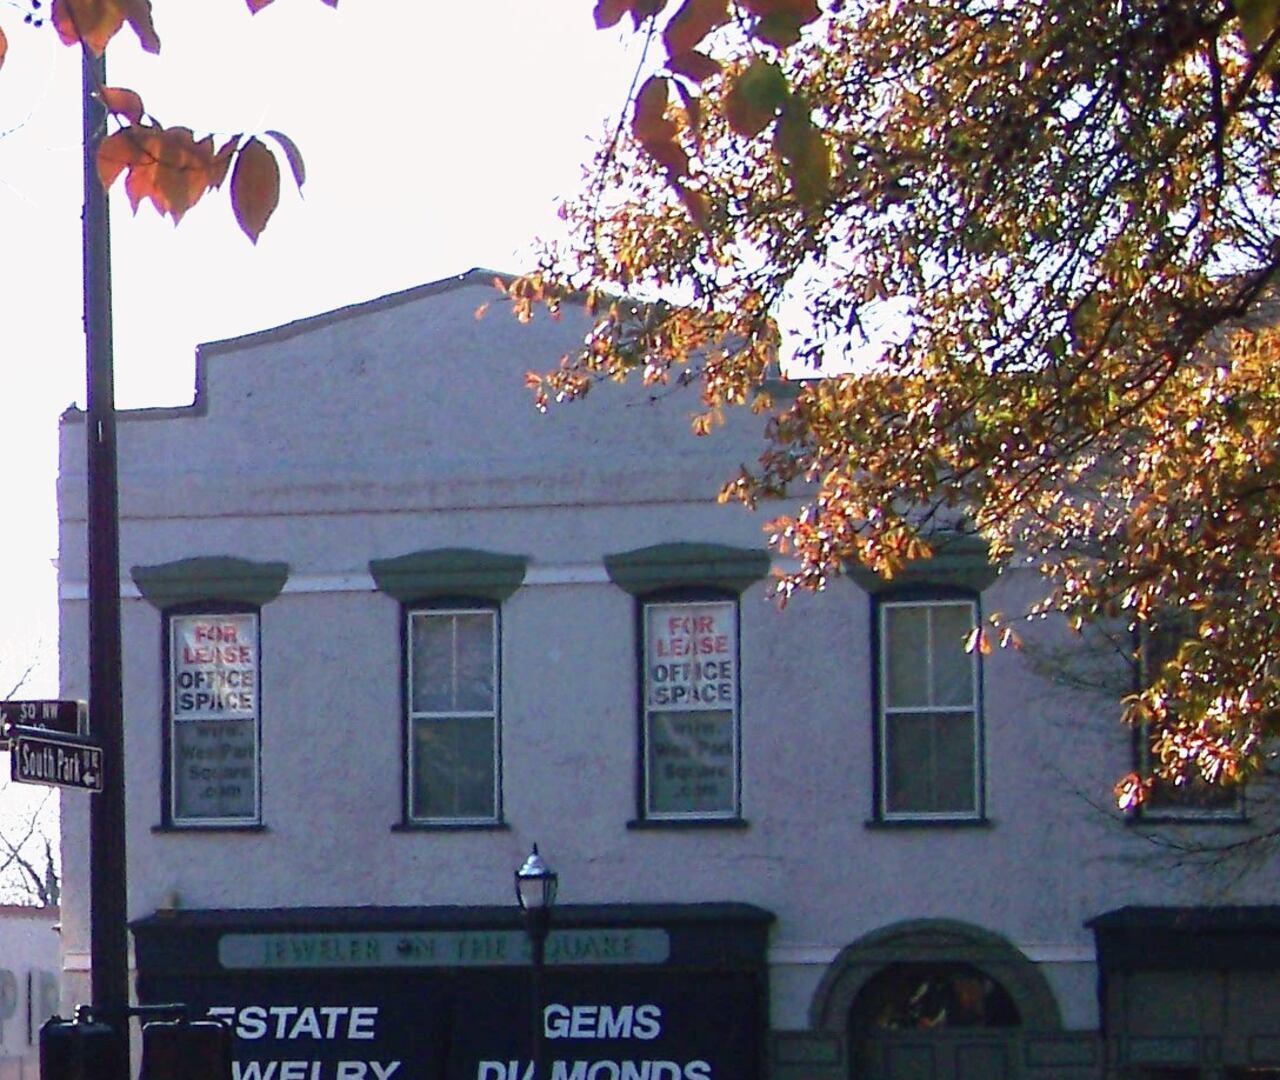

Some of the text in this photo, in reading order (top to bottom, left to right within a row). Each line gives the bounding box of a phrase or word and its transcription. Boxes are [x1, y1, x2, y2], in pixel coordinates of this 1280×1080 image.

[194, 624, 238, 643] FOR
[668, 616, 715, 636] FOR
[183, 646, 252, 665] LEASE
[656, 636, 729, 658] LEASE
[178, 669, 254, 689] OFFICE
[653, 660, 733, 683] OFFICE
[180, 693, 253, 711] SPACE
[654, 682, 733, 705] SPACE
[20, 703, 36, 721] SQ
[42, 703, 58, 719] NW
[23, 743, 55, 780] South
[57, 747, 80, 783] Park
[544, 1004, 663, 1040] GEMS
